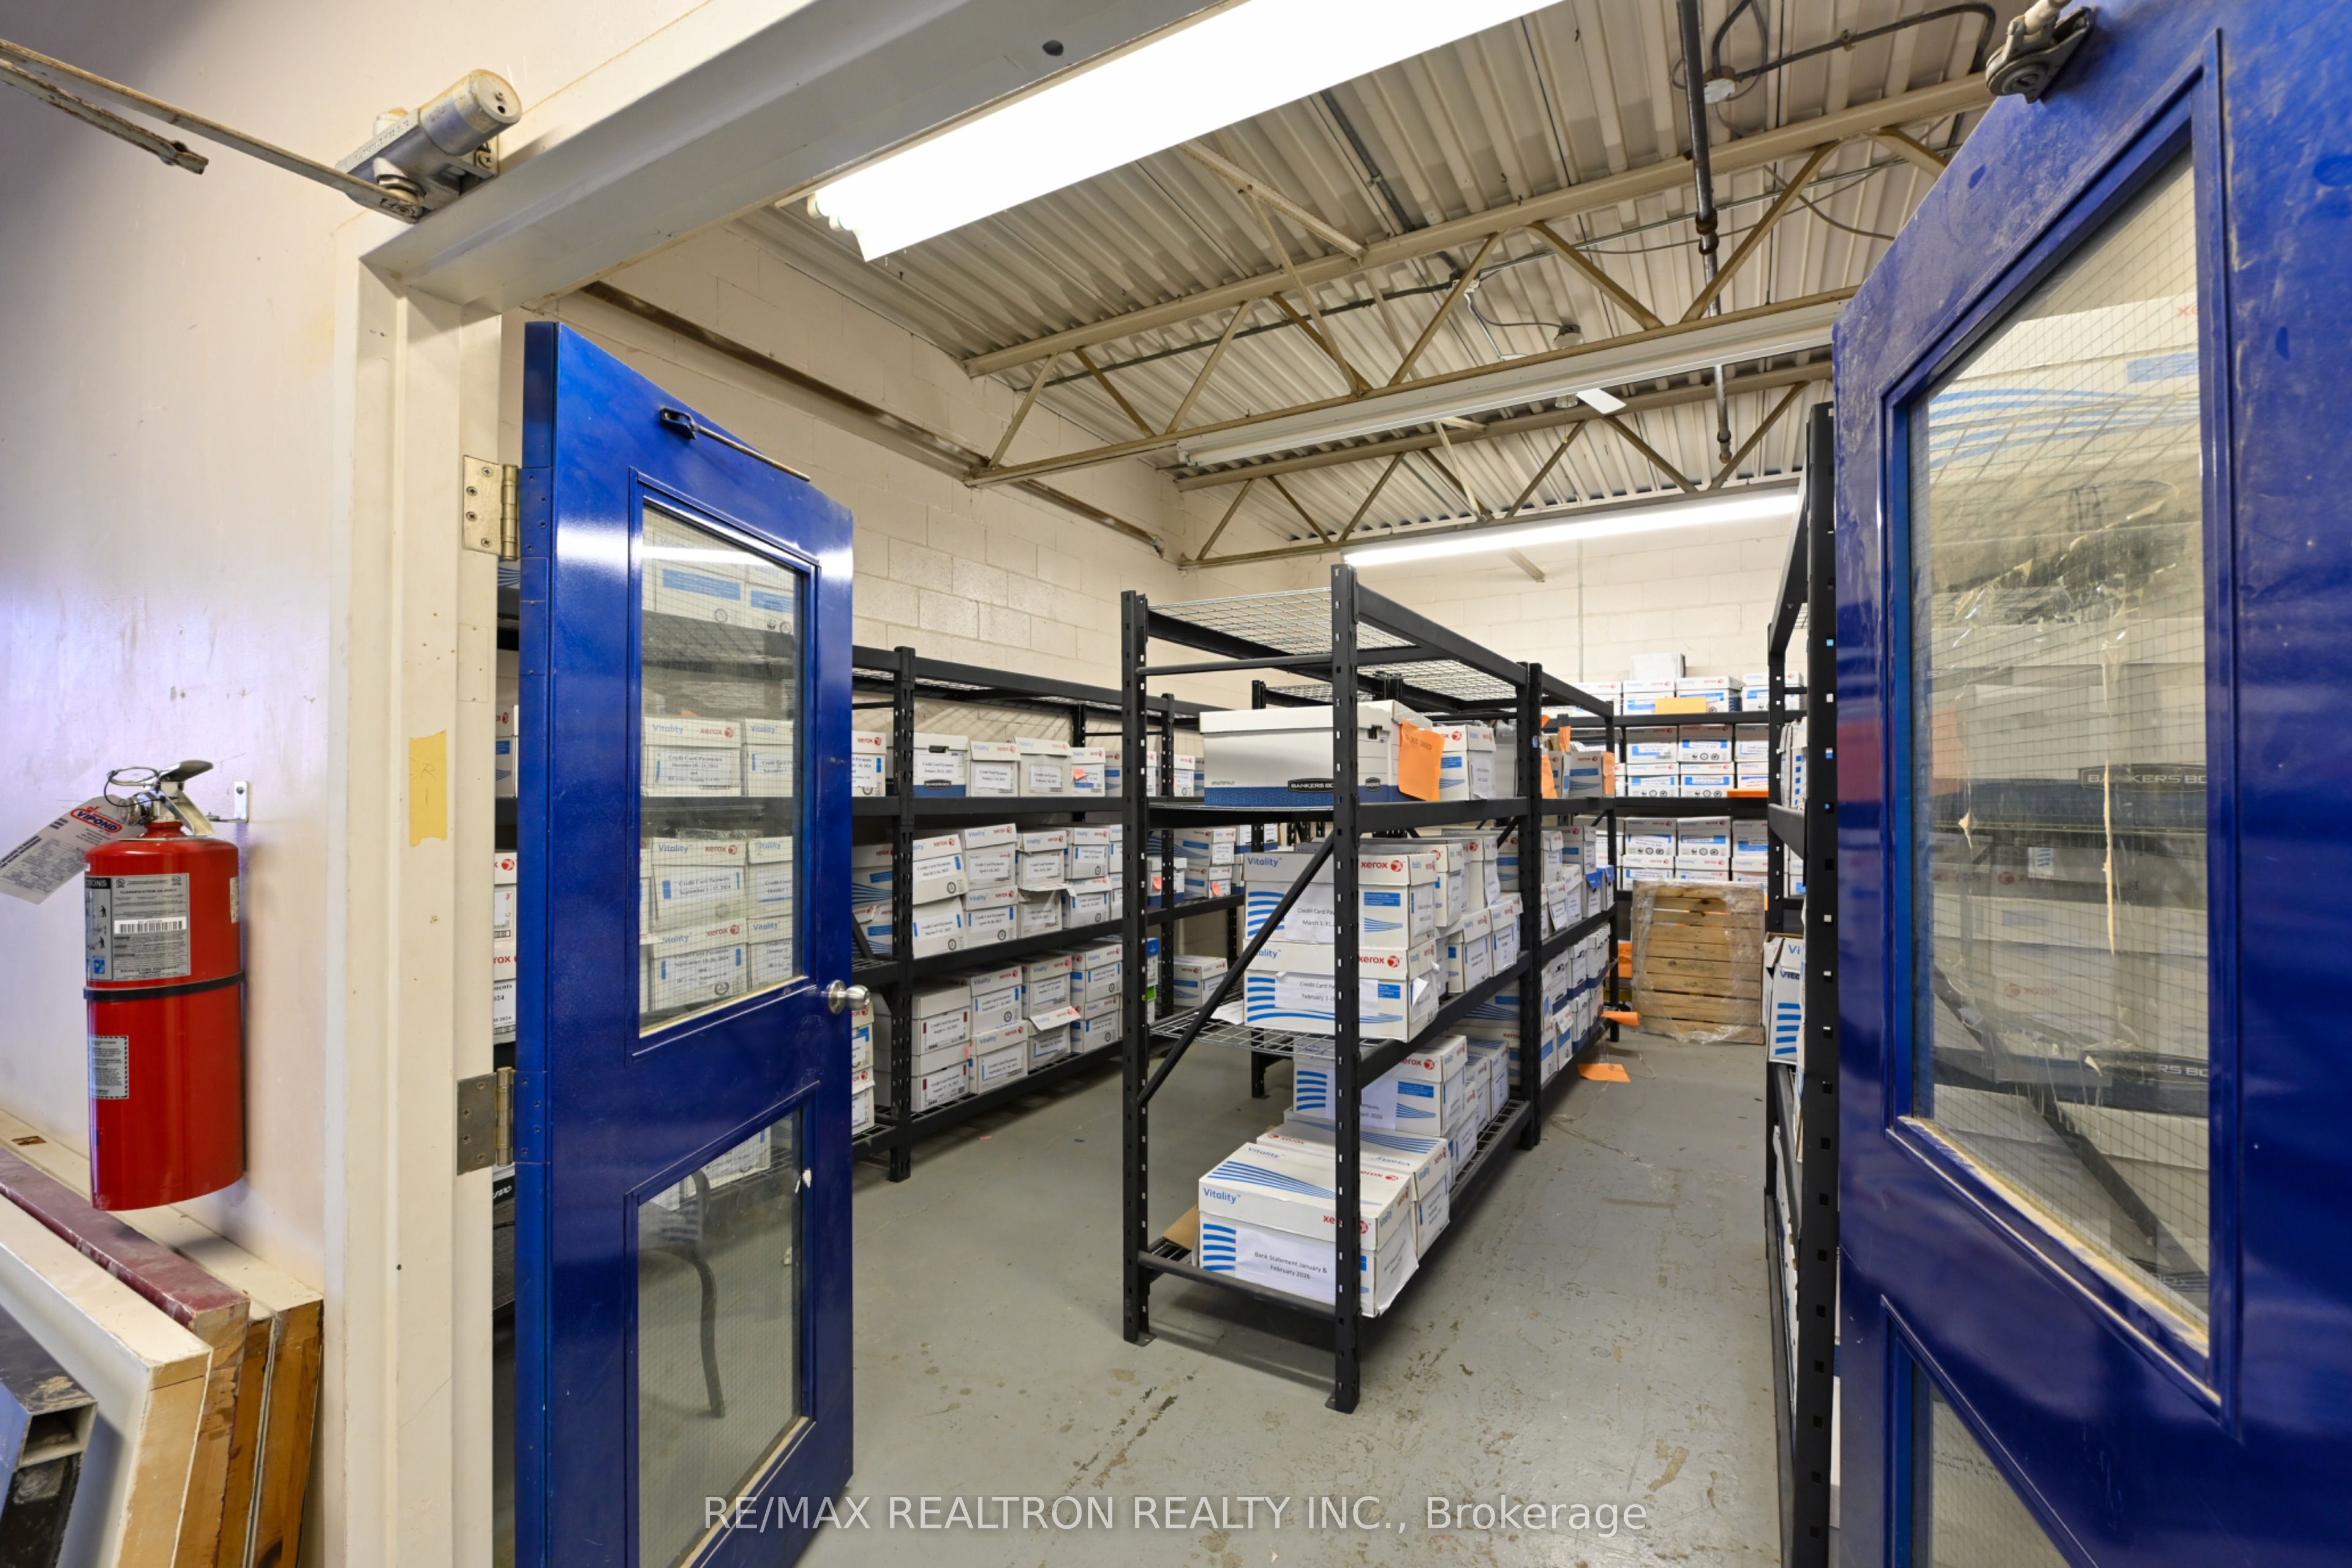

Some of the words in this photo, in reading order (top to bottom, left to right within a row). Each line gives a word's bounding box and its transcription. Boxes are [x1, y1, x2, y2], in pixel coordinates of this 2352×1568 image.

[652, 725, 684, 733] Vitality
[2088, 775, 2180, 783] BKERS
[2185, 775, 2207, 784] BO
[77, 811, 118, 831] VIPOND
[658, 844, 688, 853] Vitality
[1247, 858, 1278, 867] Vitality
[1256, 950, 1278, 959] ality
[494, 956, 511, 964] rox
[2185, 1067, 2209, 1077] BO
[1248, 1147, 1280, 1158] Vitality
[1204, 1188, 1236, 1204] Vitality
[1269, 1254, 1297, 1267] Statement
[1299, 1262, 1322, 1273] January
[1270, 1265, 1295, 1276] February
